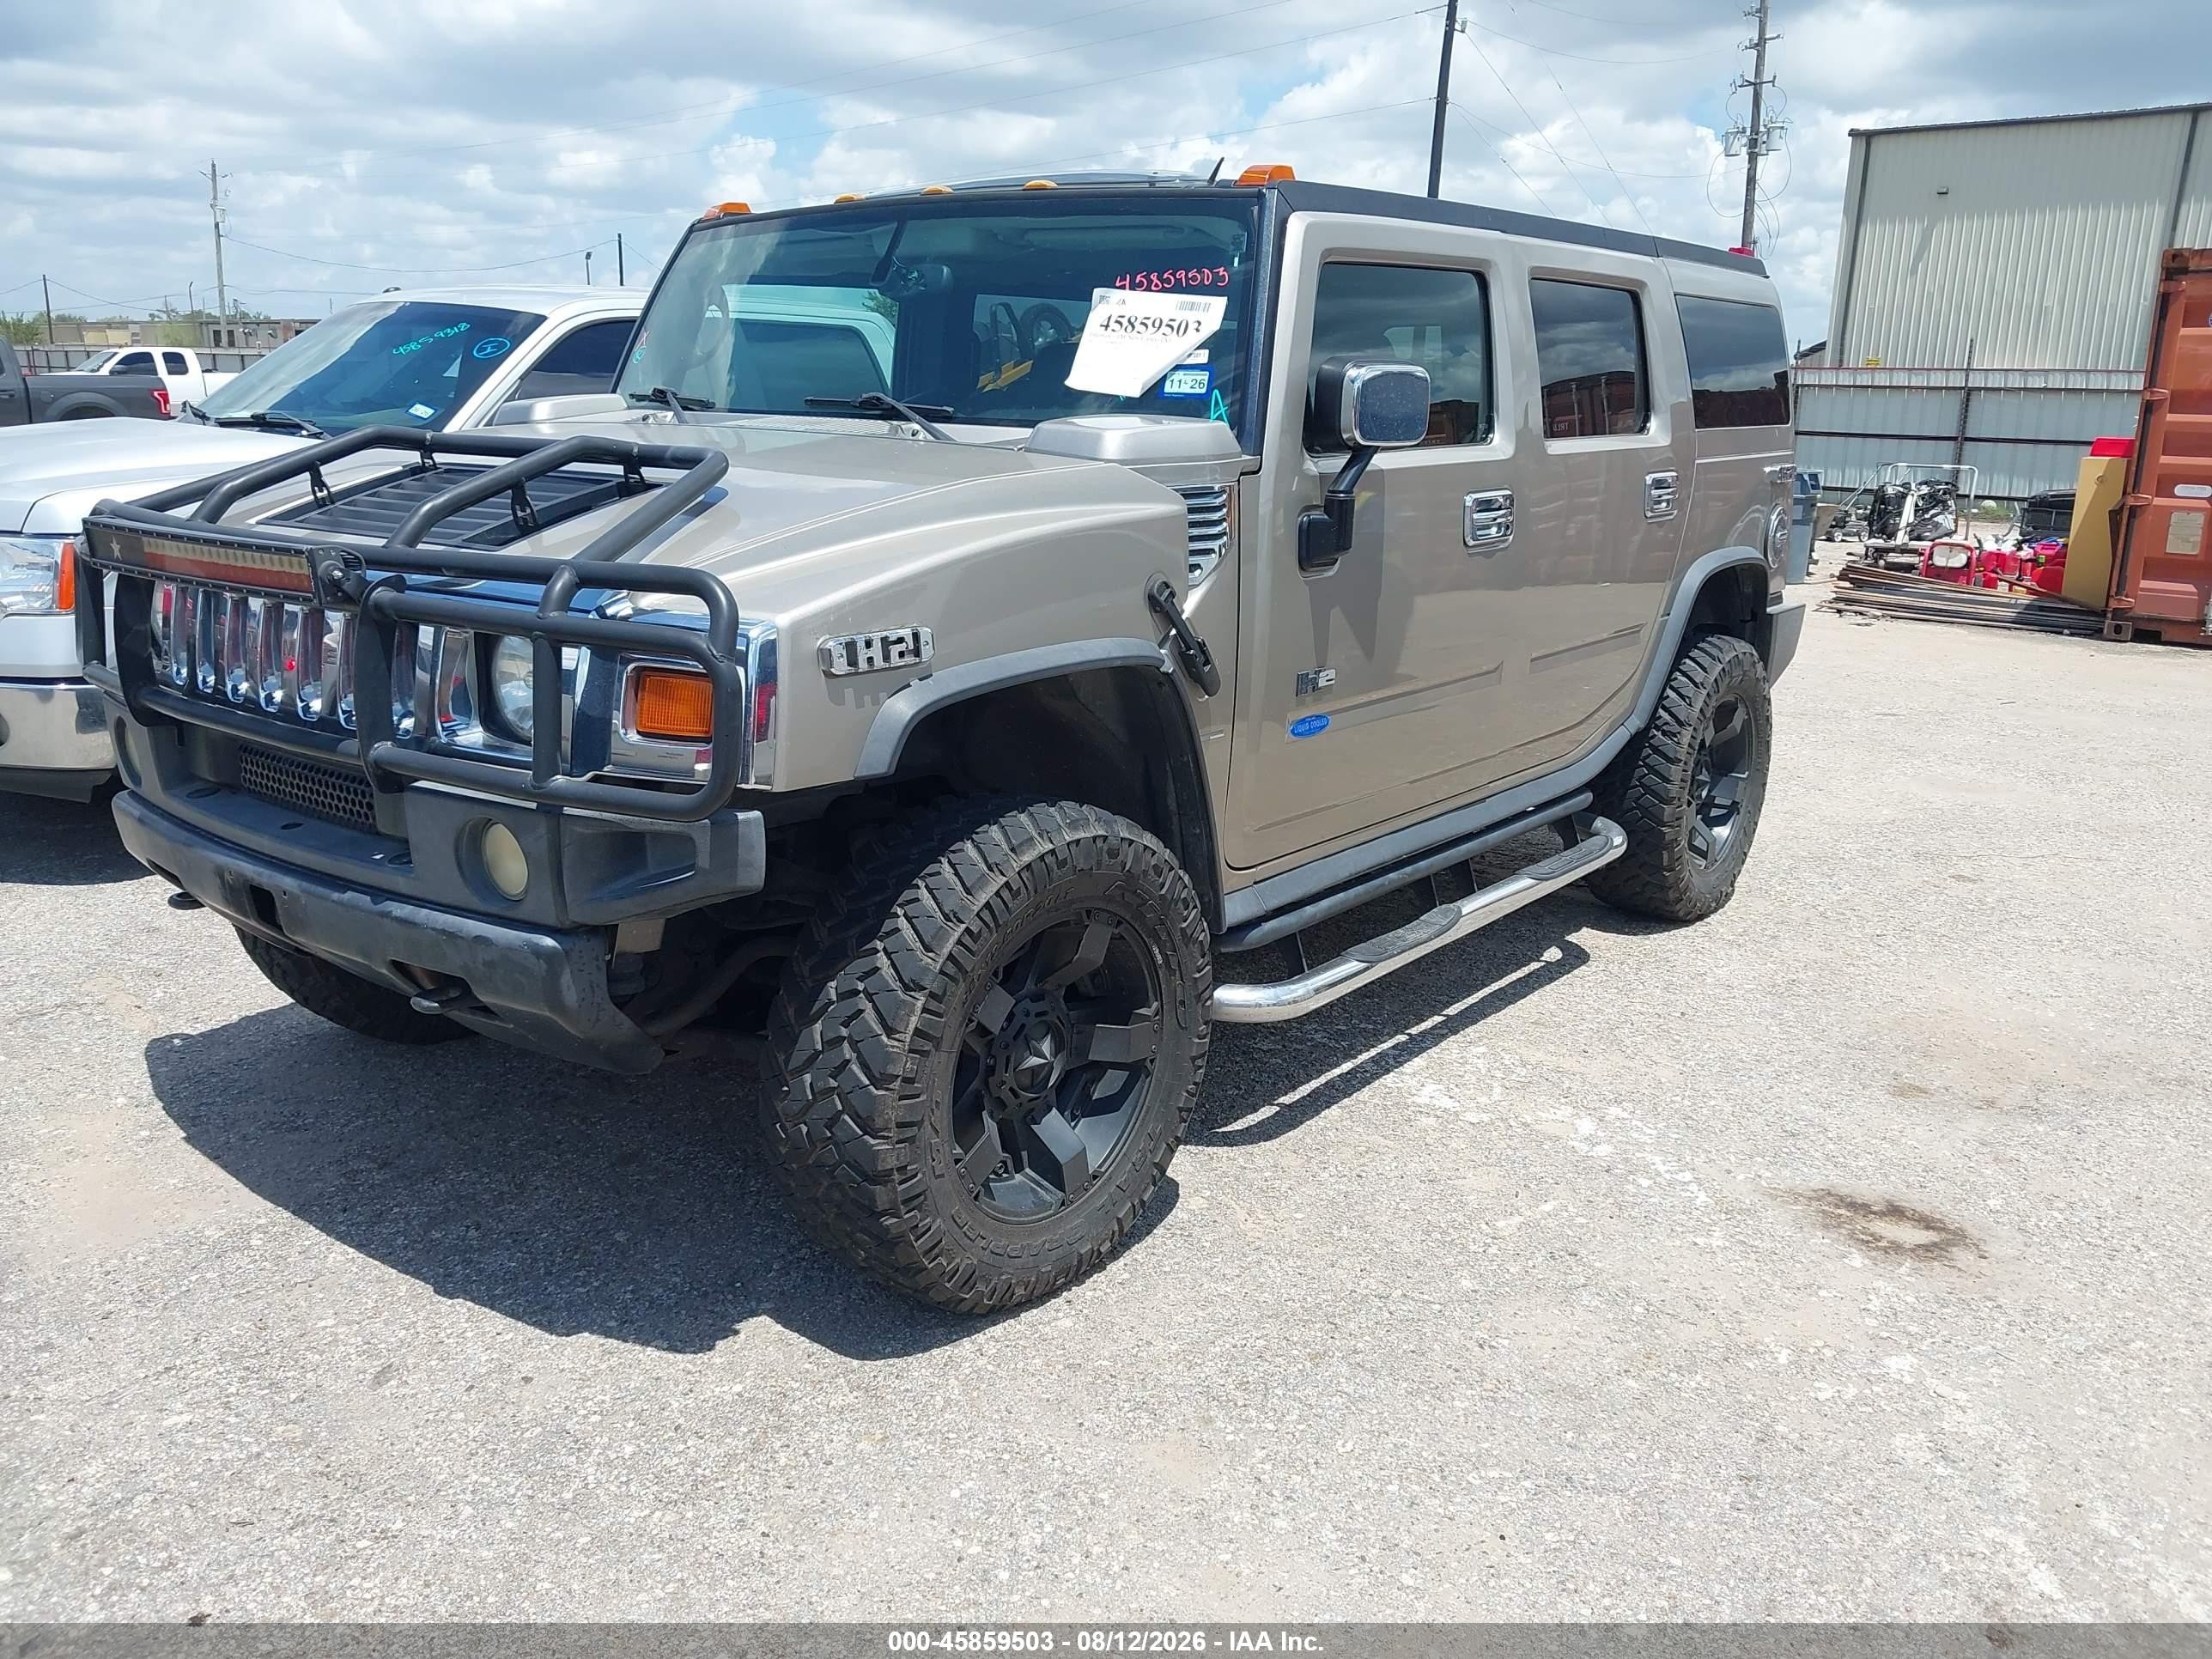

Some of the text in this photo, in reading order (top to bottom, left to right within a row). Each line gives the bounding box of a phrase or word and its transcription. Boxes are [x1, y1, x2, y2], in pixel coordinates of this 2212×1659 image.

[1115, 267, 1230, 291] 45859503
[1169, 378, 1206, 389] 11 26
[1209, 389, 1230, 425] A
[857, 629, 915, 672] H2
[1295, 667, 1335, 696] H2
